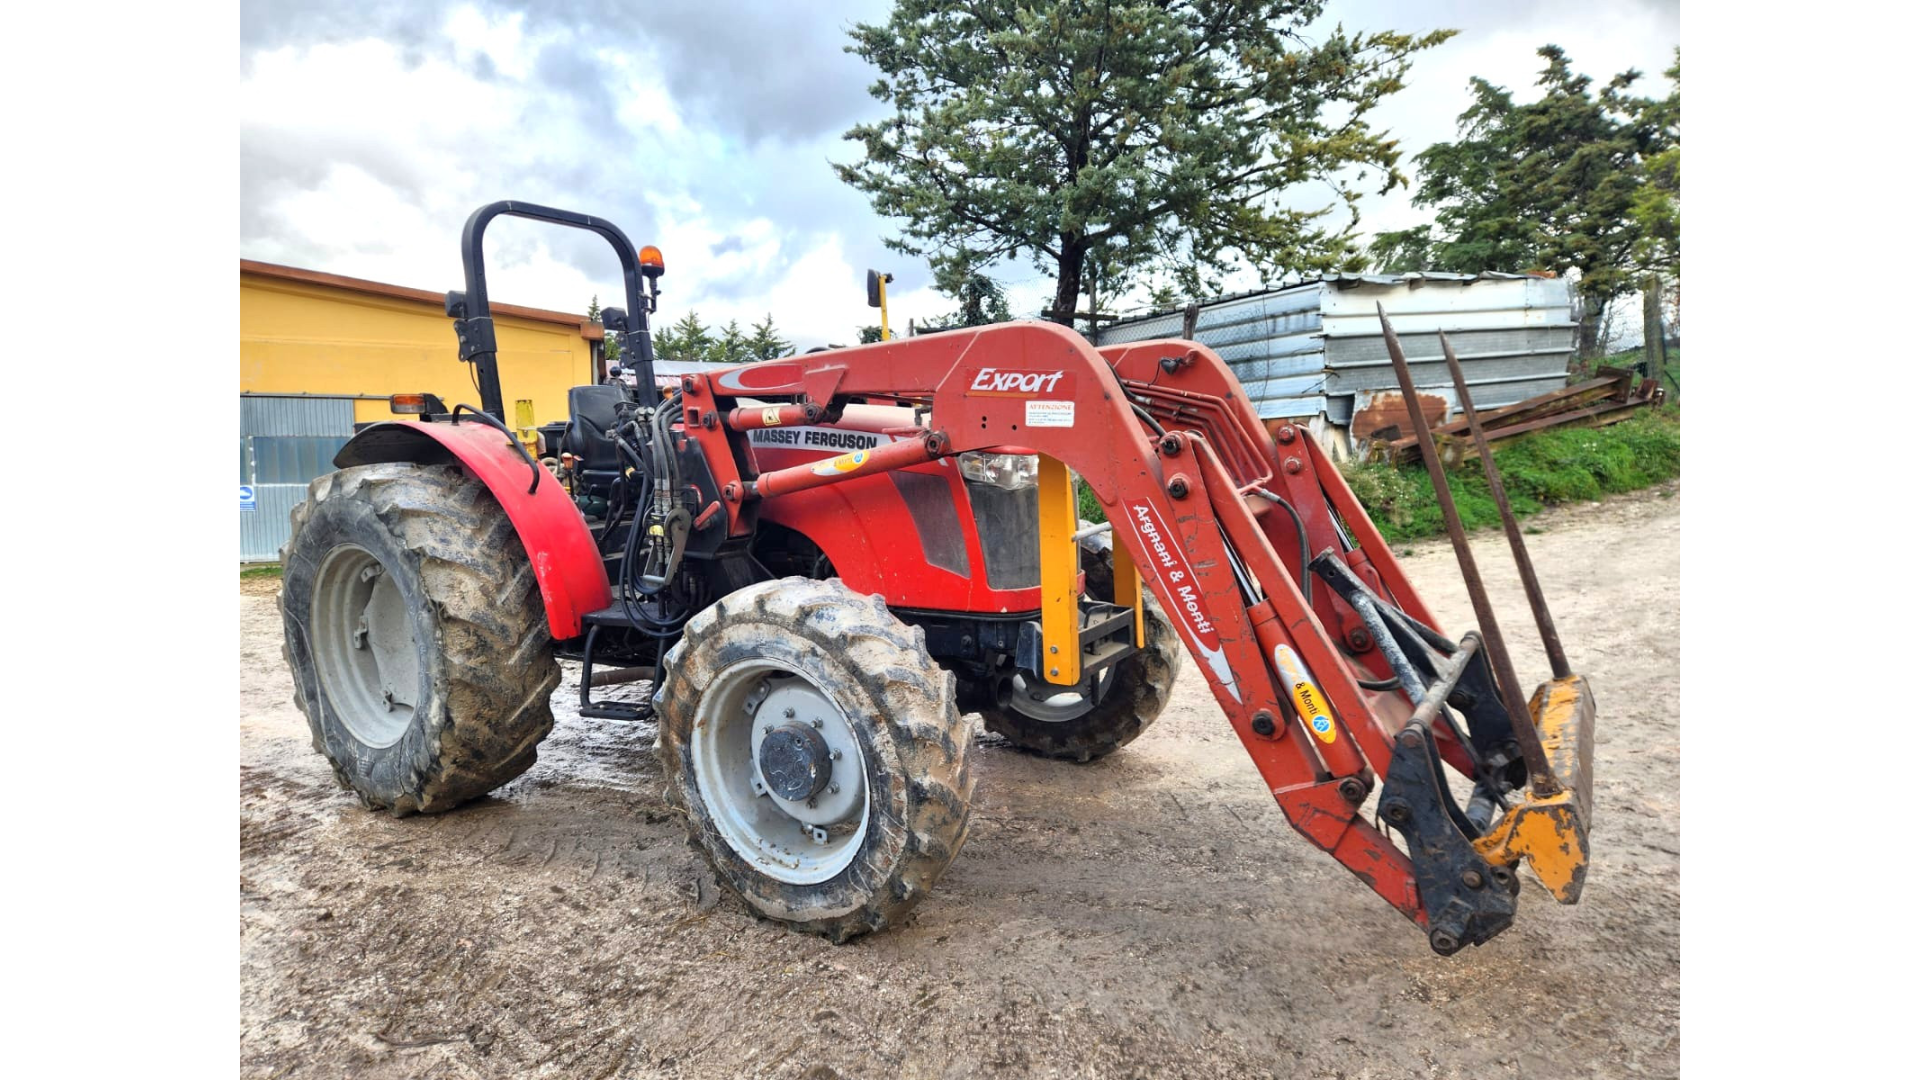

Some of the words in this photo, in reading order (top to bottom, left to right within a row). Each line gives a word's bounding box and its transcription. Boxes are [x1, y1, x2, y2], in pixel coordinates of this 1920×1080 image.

[970, 368, 1064, 392] Export
[753, 429, 801, 444] MASSEY
[804, 430, 877, 450] FERGUSON
[1133, 505, 1177, 568] Argnani
[1169, 570, 1185, 583] &
[1177, 584, 1214, 634] Monti
[1295, 682, 1306, 690] &
[1300, 689, 1320, 715] Monti
